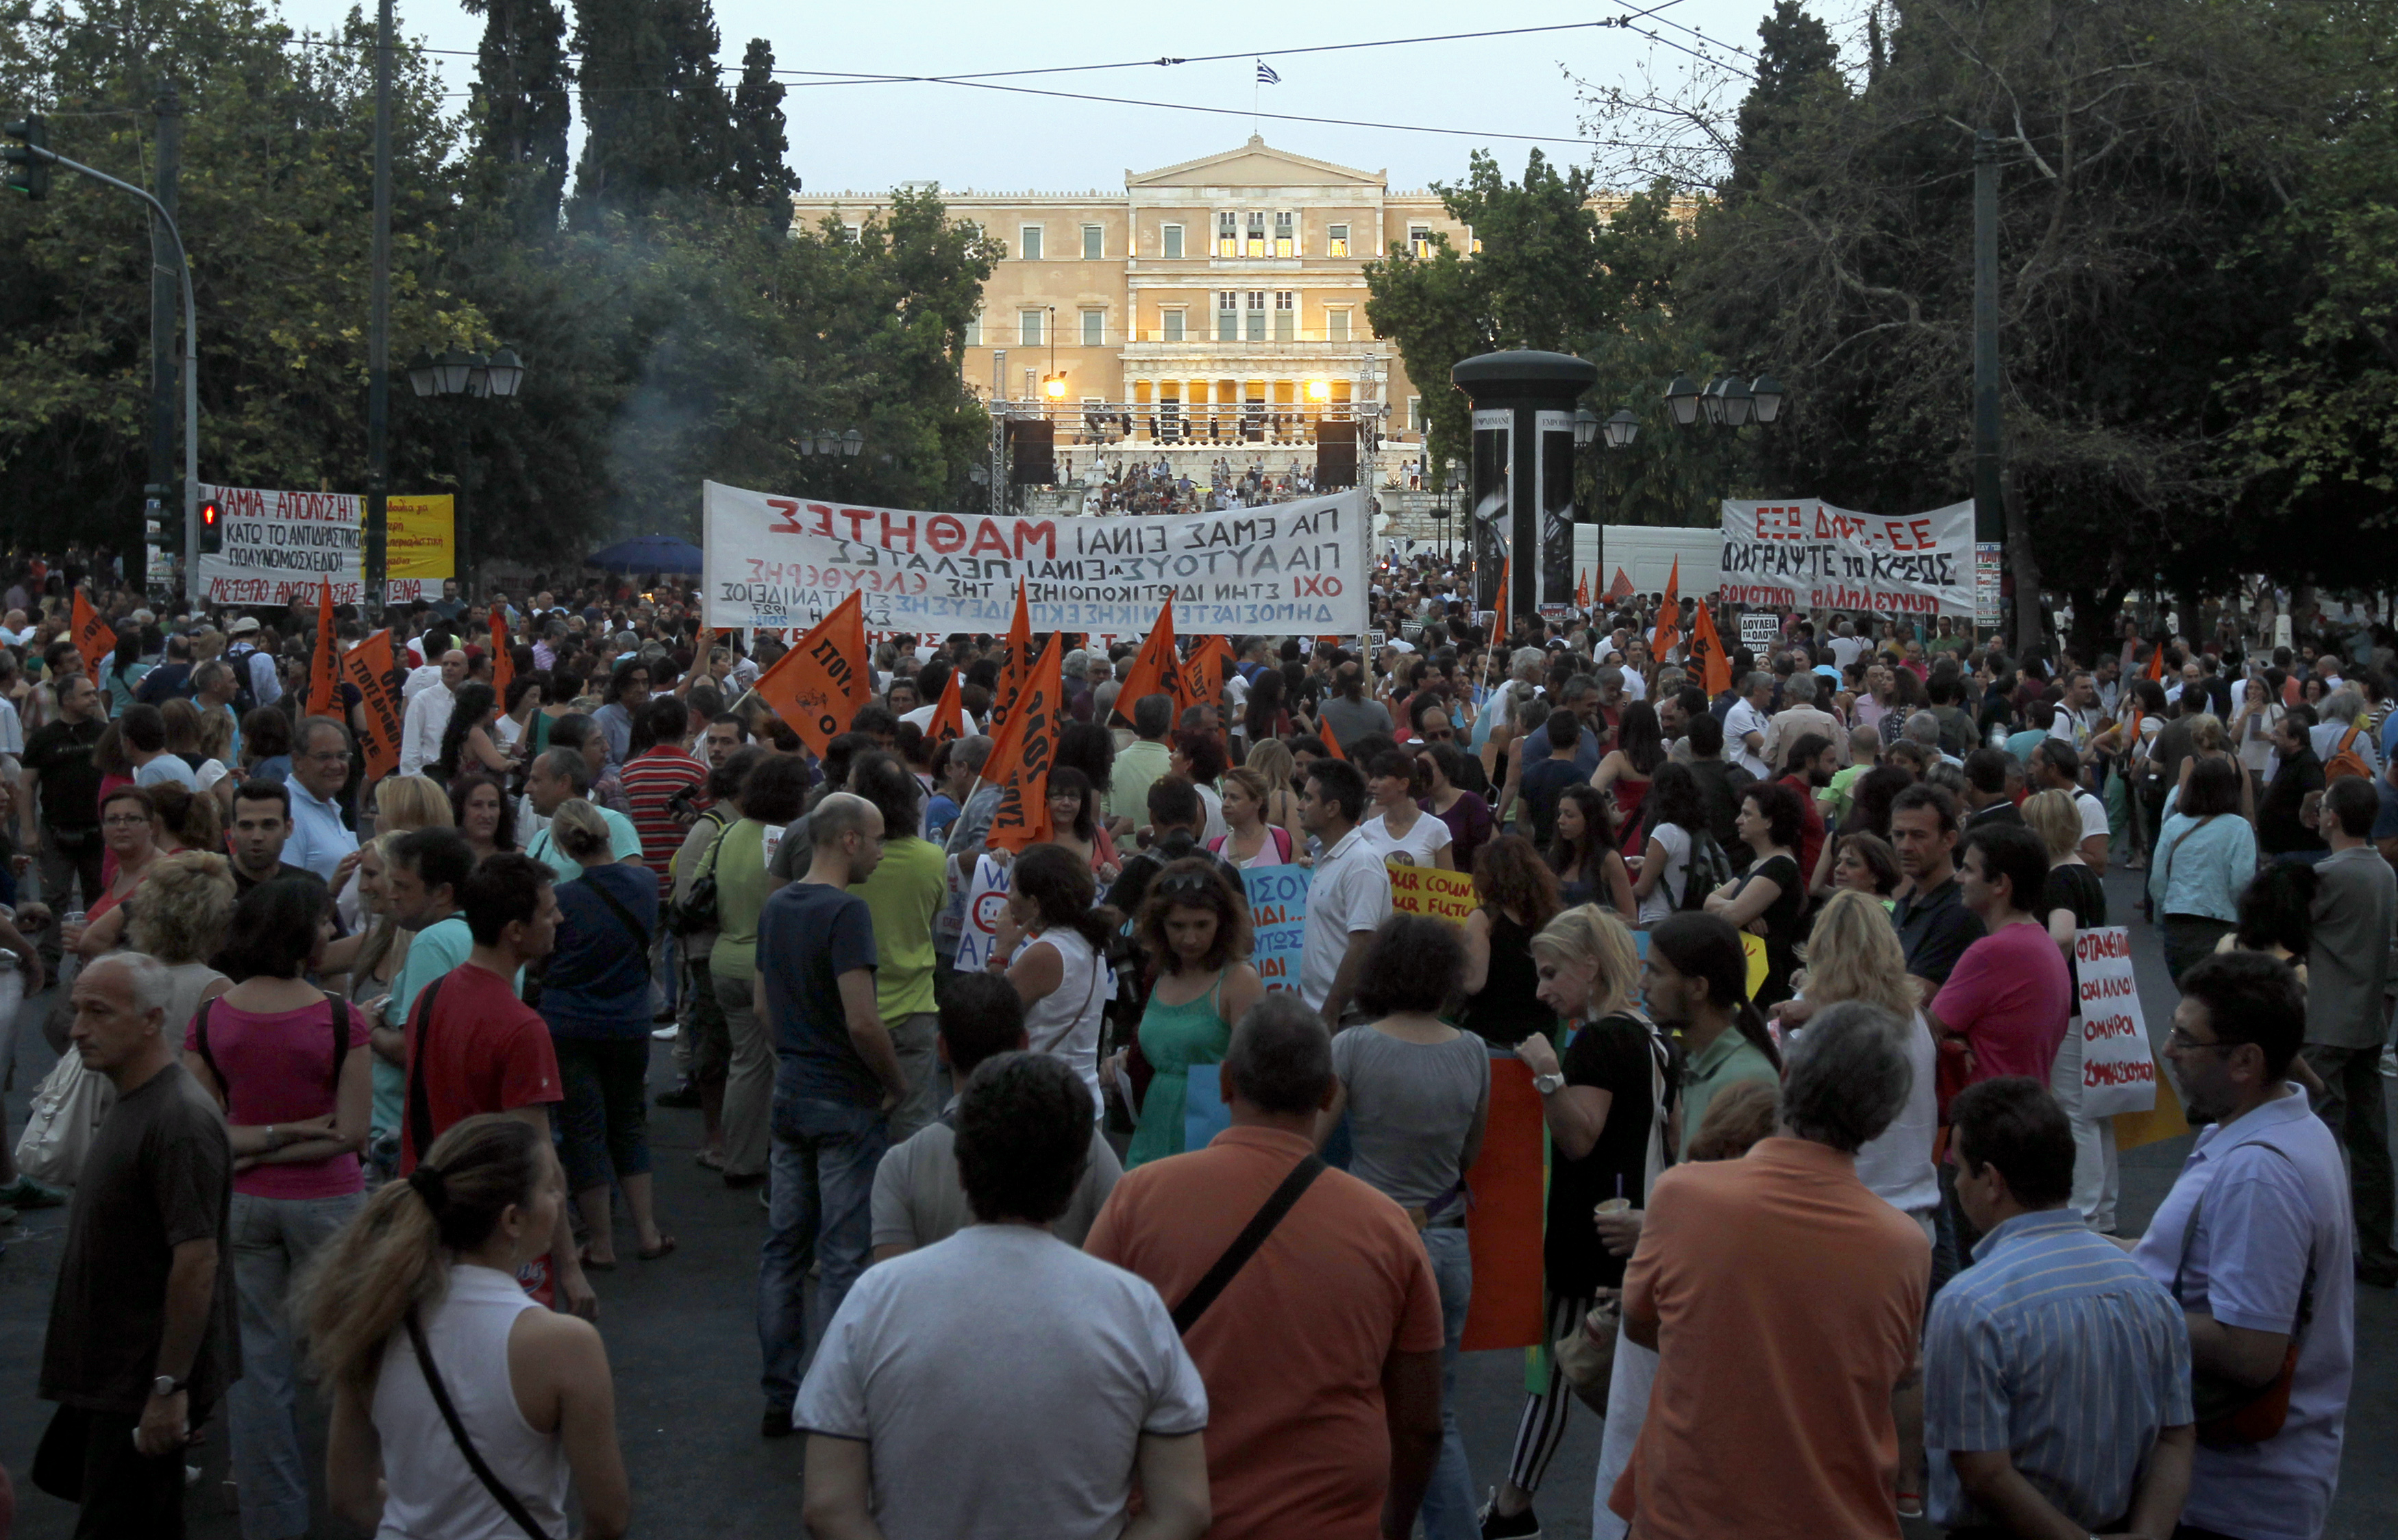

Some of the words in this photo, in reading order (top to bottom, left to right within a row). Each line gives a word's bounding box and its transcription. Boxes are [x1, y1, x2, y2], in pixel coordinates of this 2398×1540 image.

[277, 491, 353, 522] ΑΠΟΛΥΣΗ!
[226, 523, 263, 545] ΚΑΤΩ
[267, 525, 286, 546] ΤΟ
[289, 525, 361, 549] ΑΝΤΙΔΡΑΣΤΙΚΟ
[1756, 506, 1802, 540] ΕΞΩ
[229, 547, 343, 572] ΠΟΛΥΝΟΜΟΣΧΕΔΙΟ!
[1721, 542, 1837, 578] ΔΙΑΓΡΑΨΤΕ
[208, 577, 269, 603] ΜΕΤΩΠΟ
[276, 579, 358, 607] ΑΝΤΙΣΤΣΗΣ
[1742, 619, 1777, 630] ΔΟΥΛΕΙΑ
[349, 658, 380, 699] ΣΤΟΥΣ
[1426, 875, 1473, 898] COUN
[1392, 895, 1420, 913] UR
[1428, 897, 1474, 918] FUTU
[2080, 978, 2101, 1000] ΟΧΙ
[2103, 976, 2135, 998] ΑΛΛΟΙ
[2084, 1013, 2137, 1041] ΟΜΗΡΟΙ
